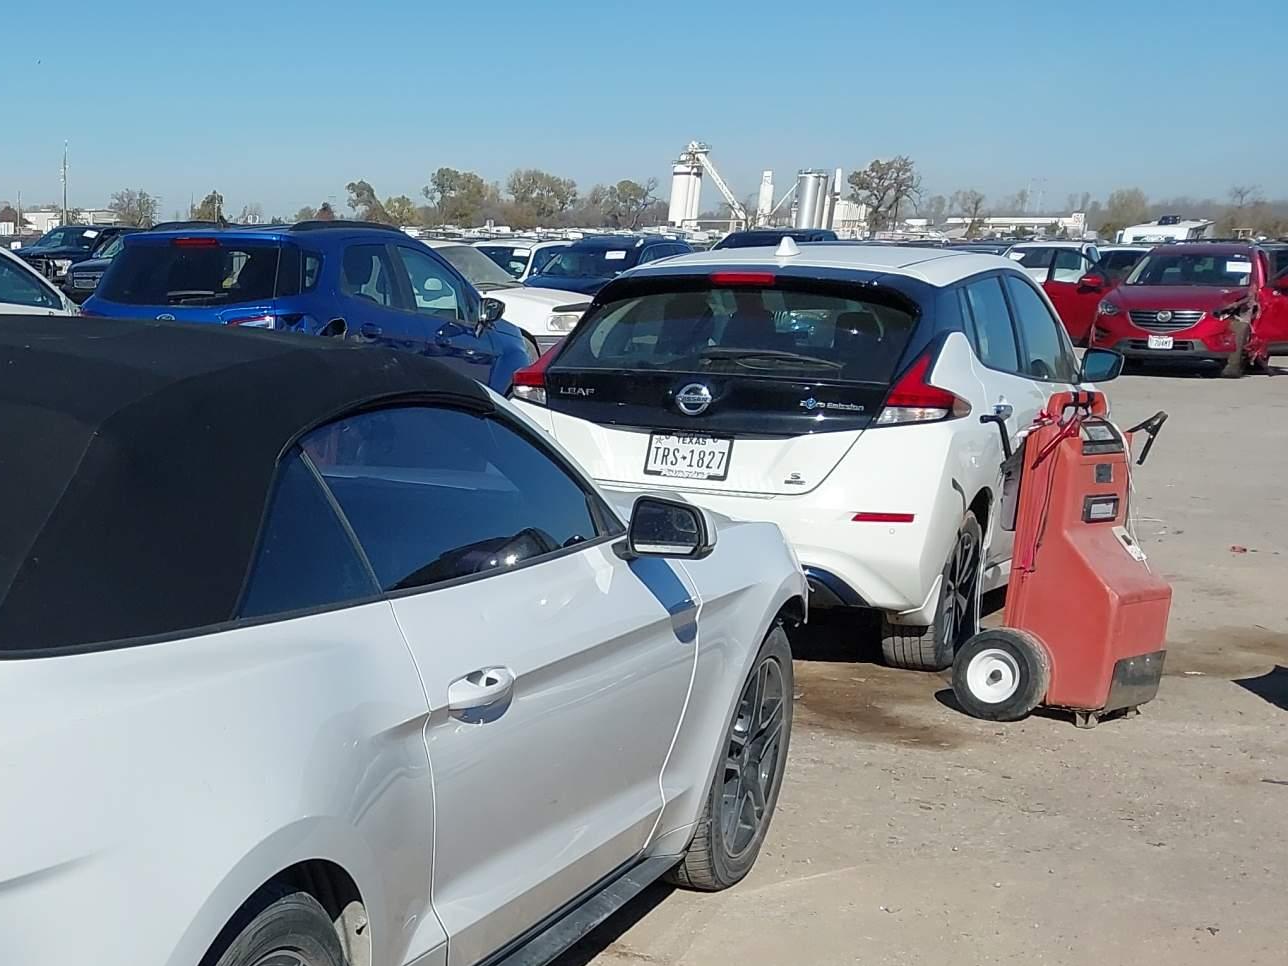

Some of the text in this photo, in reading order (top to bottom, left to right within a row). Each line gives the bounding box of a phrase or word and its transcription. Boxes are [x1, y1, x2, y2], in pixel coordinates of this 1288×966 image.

[559, 386, 595, 396] LEAF
[677, 436, 708, 446] TEXAS
[790, 472, 801, 480] S
